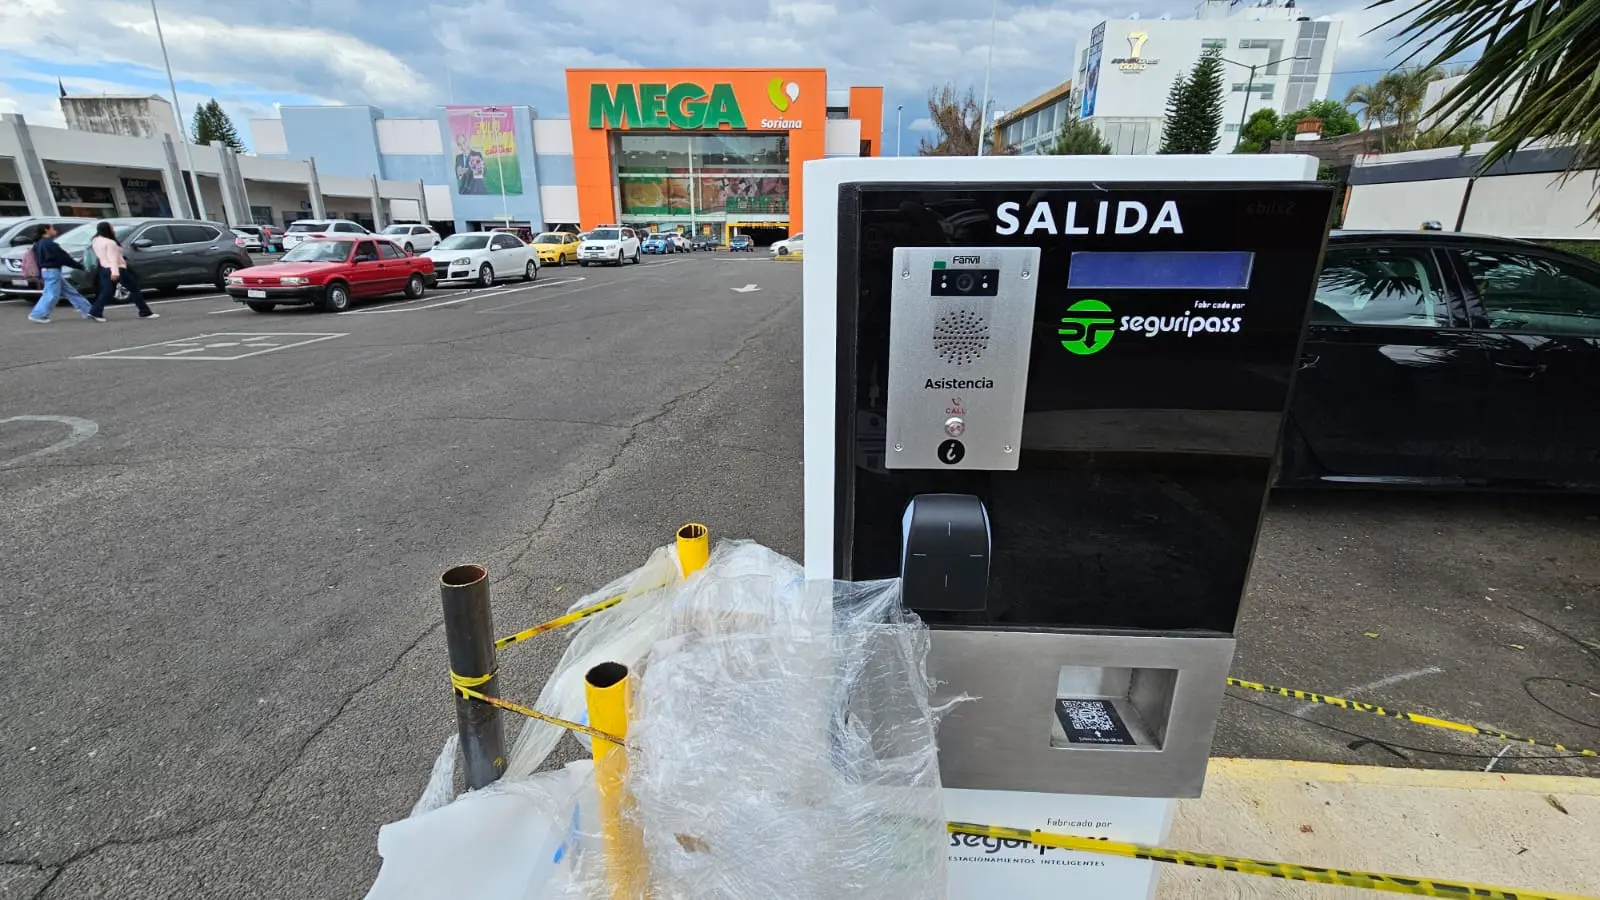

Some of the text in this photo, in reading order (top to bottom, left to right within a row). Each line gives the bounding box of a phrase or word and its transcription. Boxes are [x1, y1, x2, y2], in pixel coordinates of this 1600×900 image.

[588, 82, 747, 129] MEGA
[995, 200, 1184, 235] SALIDA
[952, 255, 981, 265] Fanvil
[1194, 300, 1246, 311] Fabrcado por
[1119, 310, 1242, 338] seguripass
[924, 377, 994, 389] Asistencia
[1047, 818, 1113, 830] Fabricado por
[948, 855, 1105, 867] ESTACIONAMIENTOS INTELIGENTES
